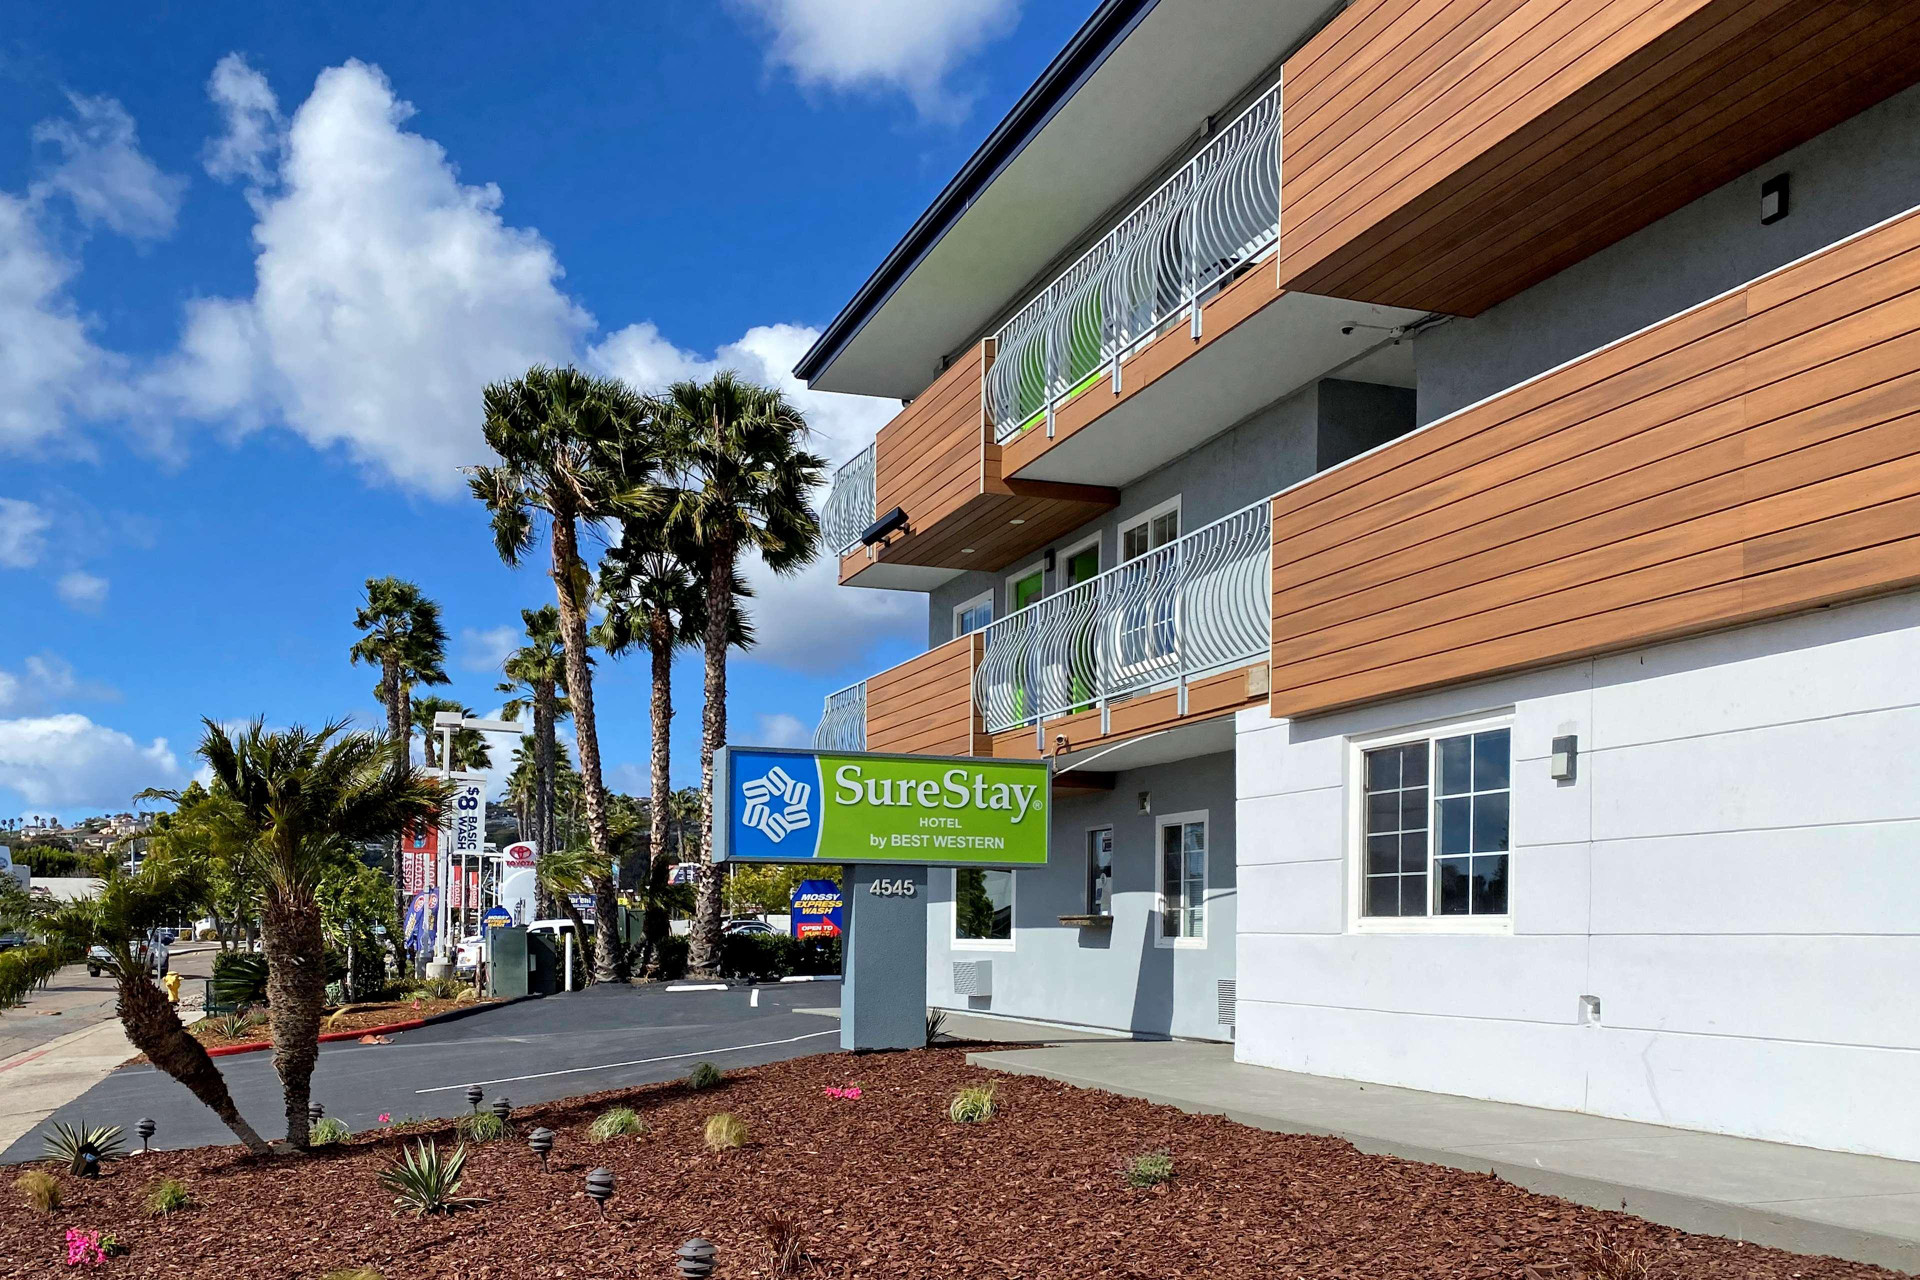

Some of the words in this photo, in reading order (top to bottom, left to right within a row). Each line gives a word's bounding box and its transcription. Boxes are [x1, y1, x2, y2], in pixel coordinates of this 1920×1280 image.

[458, 786, 480, 810] $8
[835, 765, 1037, 823] SureStay
[920, 817, 962, 828] HOTEL
[457, 816, 467, 850] WASH
[467, 816, 478, 850] BASIC
[870, 834, 887, 849] by
[891, 834, 930, 848] BEST
[933, 835, 1005, 849] WESTERN
[414, 853, 423, 892] TOYOTA
[505, 860, 536, 868] TOYOTA
[870, 879, 915, 896] 4545
[794, 900, 843, 908] EXPRESS
[802, 907, 833, 915] WASH
